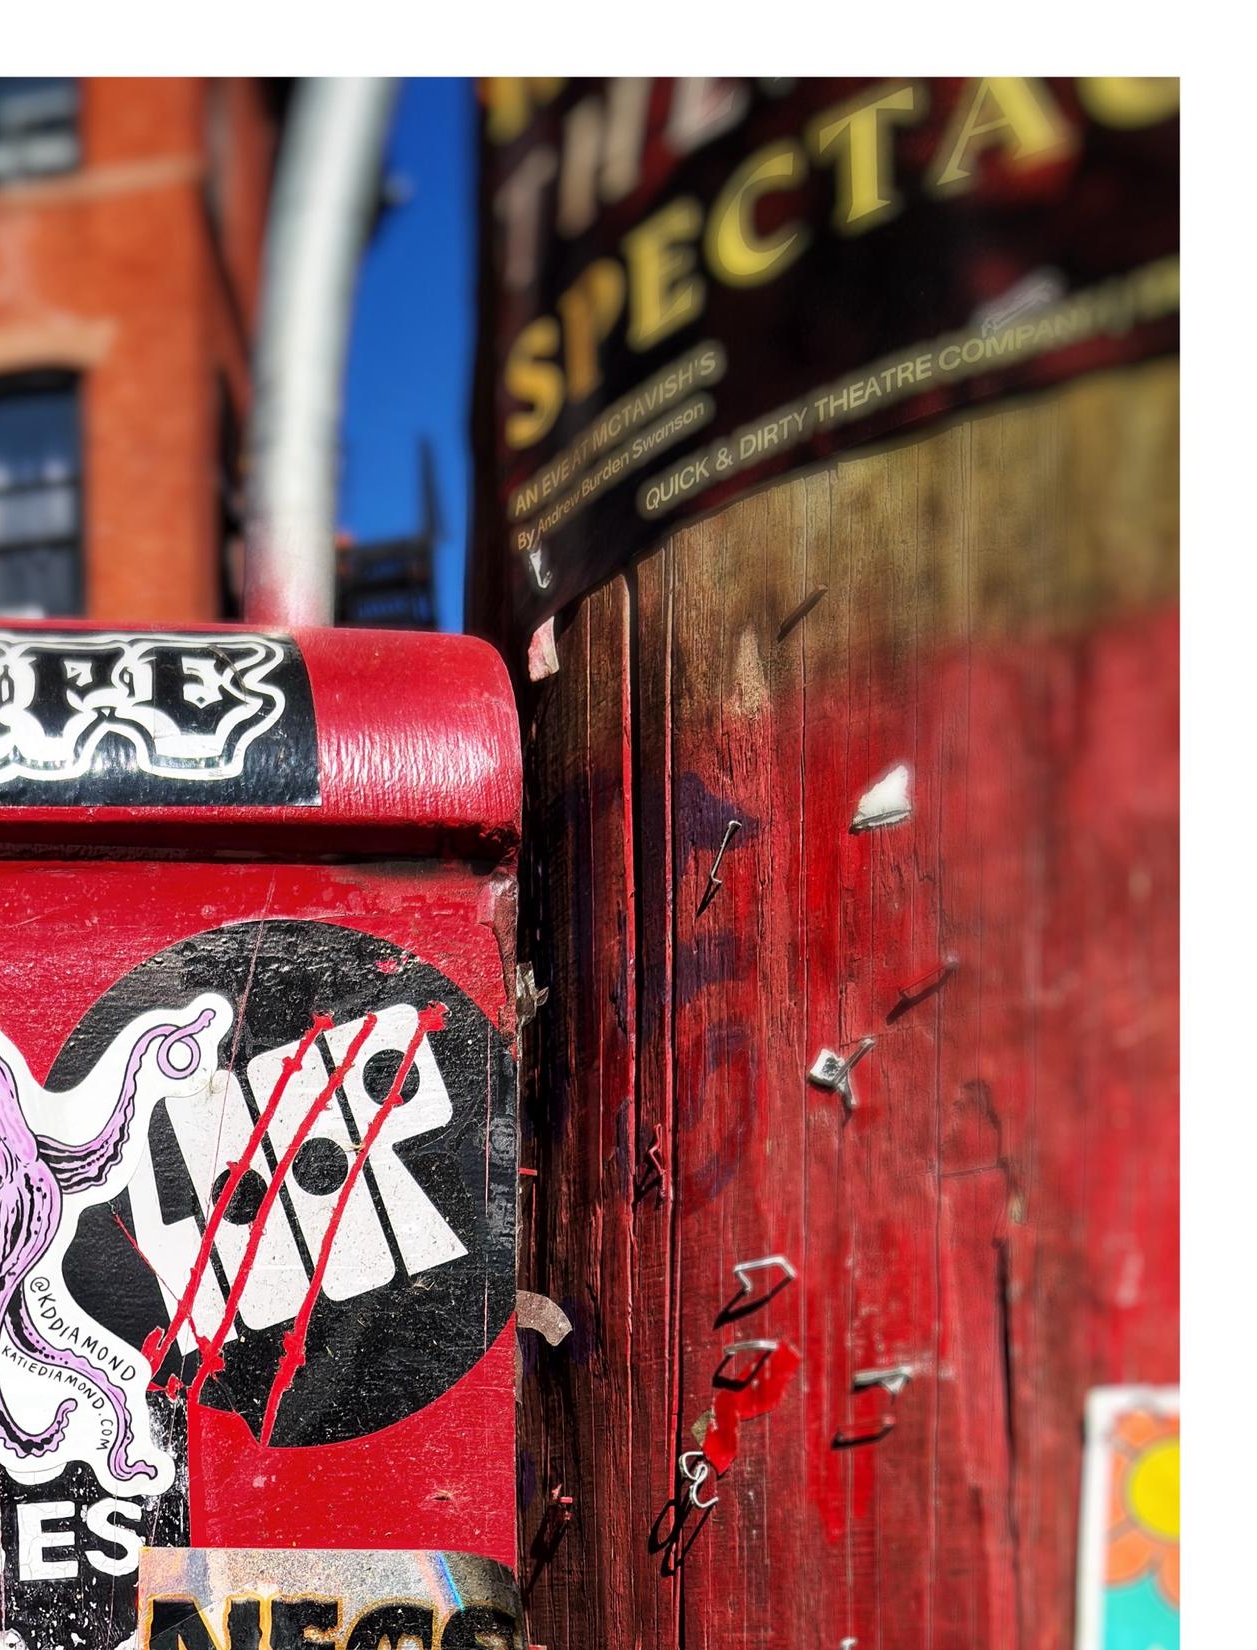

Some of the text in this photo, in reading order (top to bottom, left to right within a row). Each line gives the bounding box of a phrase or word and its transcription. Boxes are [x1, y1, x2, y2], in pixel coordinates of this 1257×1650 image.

[515, 351, 717, 517] AN EVE AT MCTAVISH'S
[517, 401, 705, 551] By Andrew Burden Swanson
[645, 300, 1093, 512] QUICK & DIRTY THEATRE COMPAN
[1, 1344, 114, 1451] KATIEDIAMOND.COM
[29, 1275, 137, 1382] @KDDIAMOND
